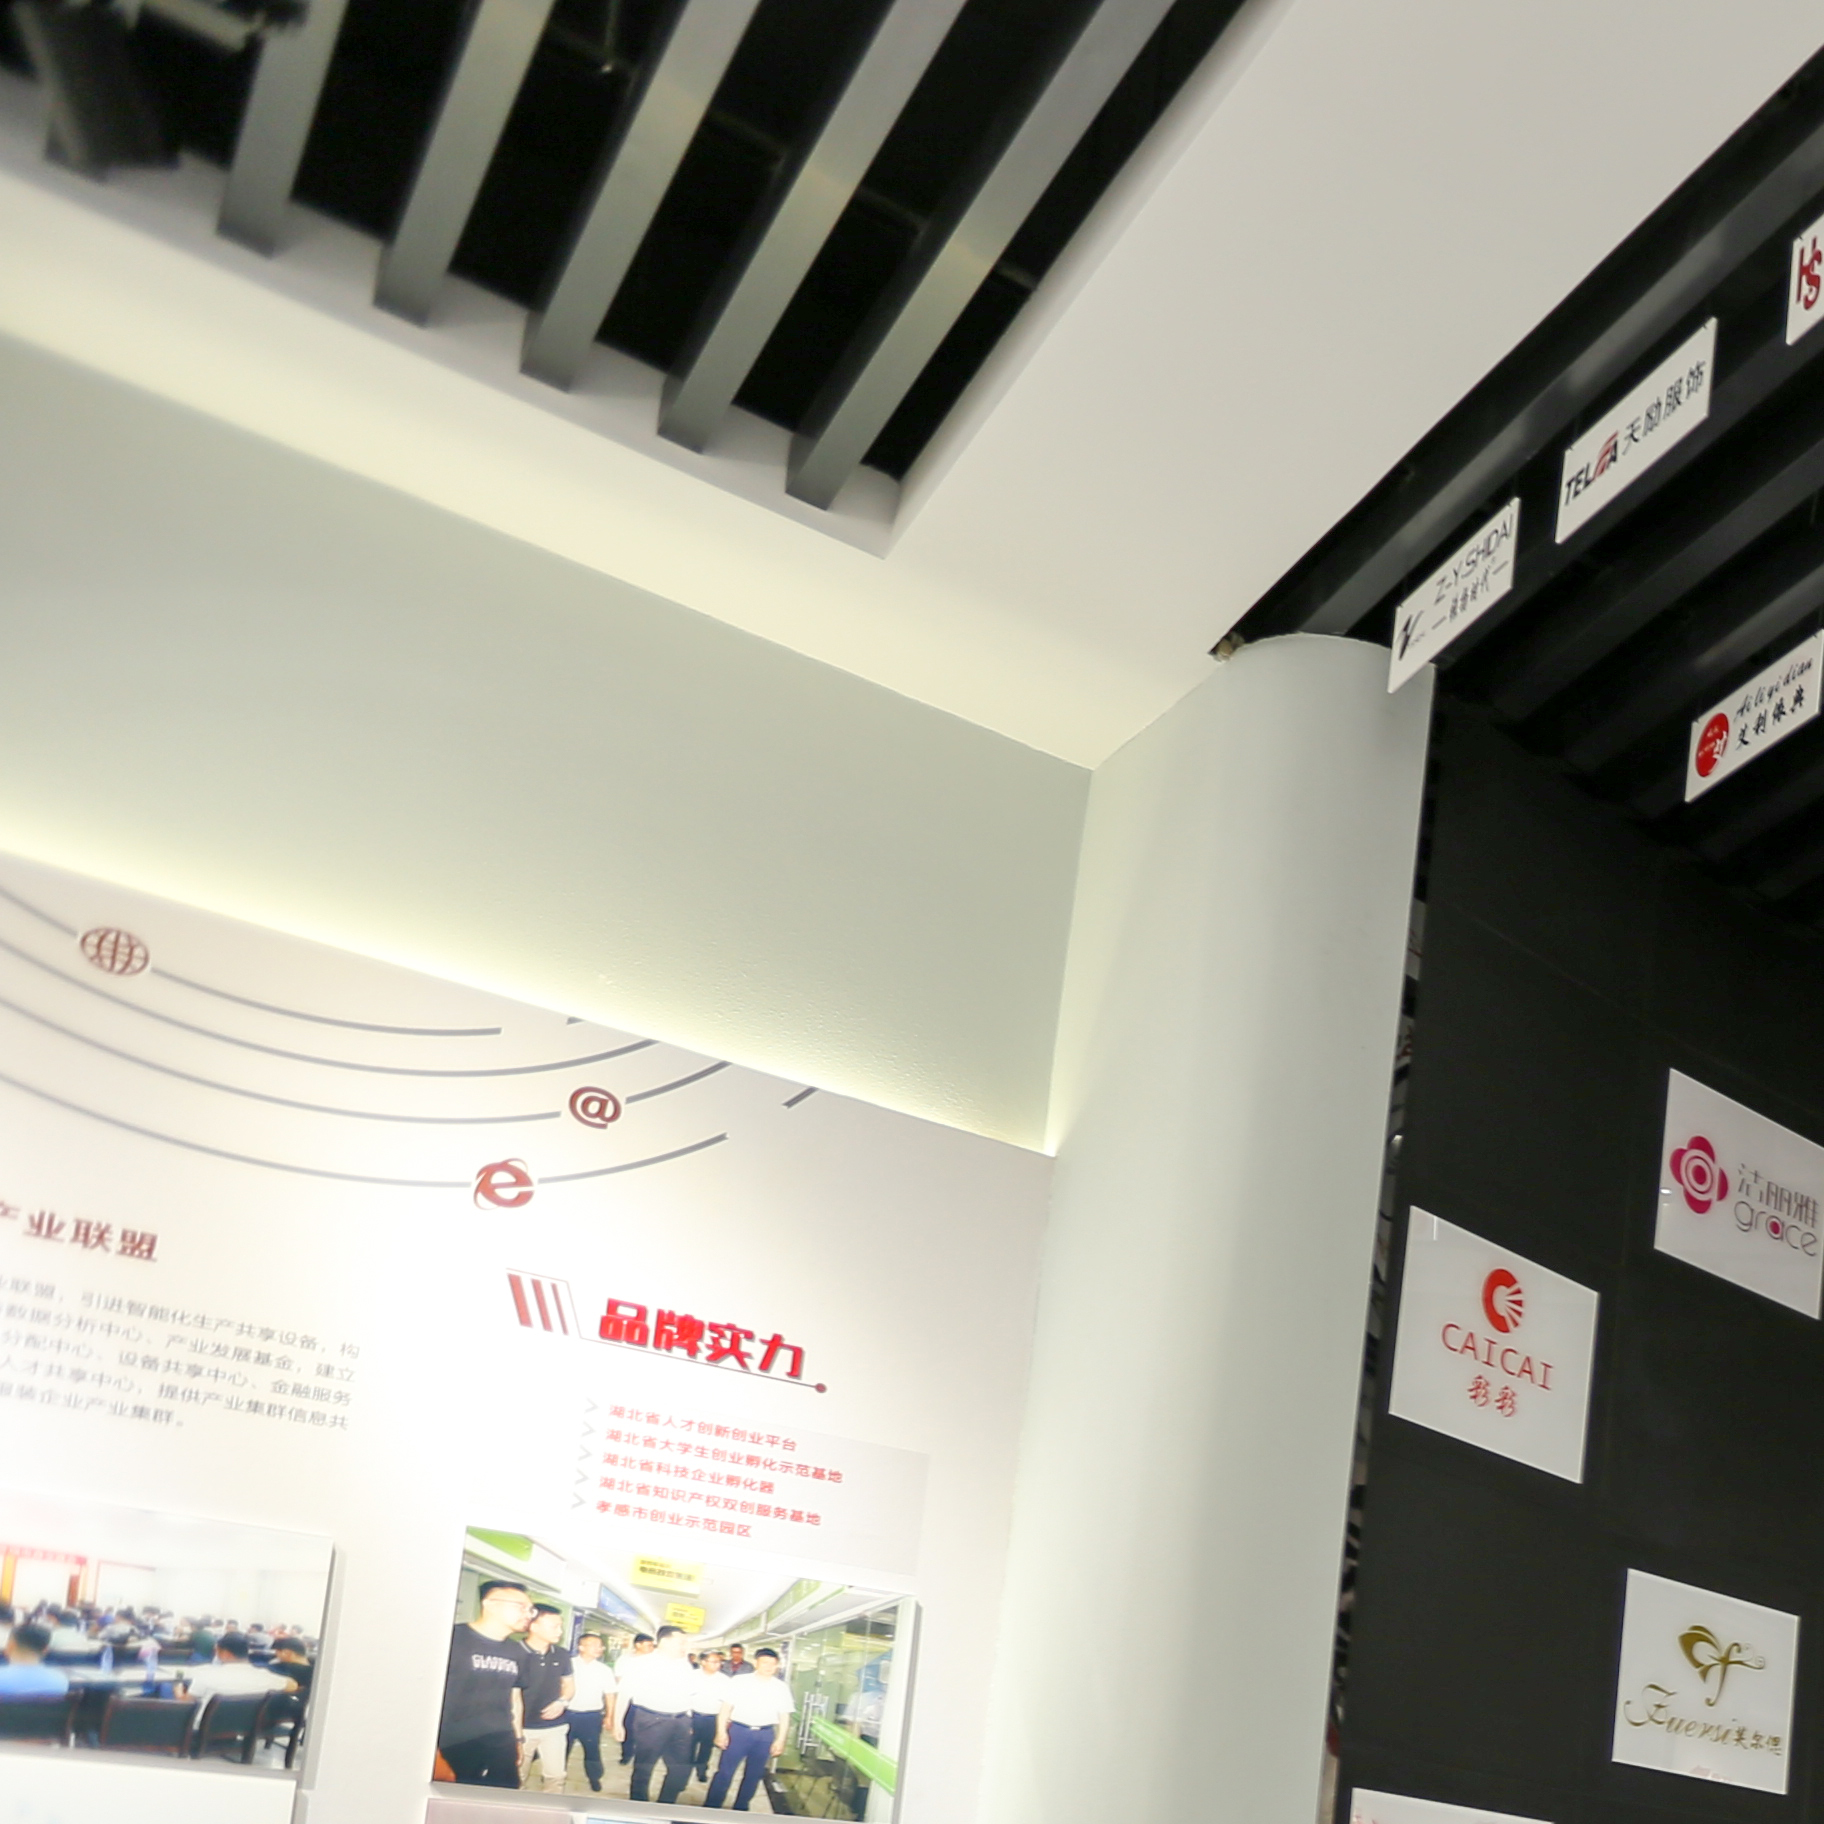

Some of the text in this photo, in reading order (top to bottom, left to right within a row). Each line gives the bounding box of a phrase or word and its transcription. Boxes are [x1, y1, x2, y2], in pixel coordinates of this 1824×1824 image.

[1737, 1163, 1819, 1229] 洁丽雅
[1733, 1201, 1817, 1257] grace
[599, 1298, 805, 1380] 品牌实力
[1441, 1323, 1554, 1391] CAICAI
[1467, 1375, 1518, 1418] 彩彩
[608, 1404, 797, 1452] 湖北省人才创新创业平台
[602, 1452, 775, 1495] 湖北省科技企业孵化器
[605, 1428, 844, 1484] 湖北省大学生创业孵化示范基地
[596, 1500, 752, 1538] 孝感市创业示范园区
[599, 1476, 822, 1526] 湖北省知识产权双创服务基地
